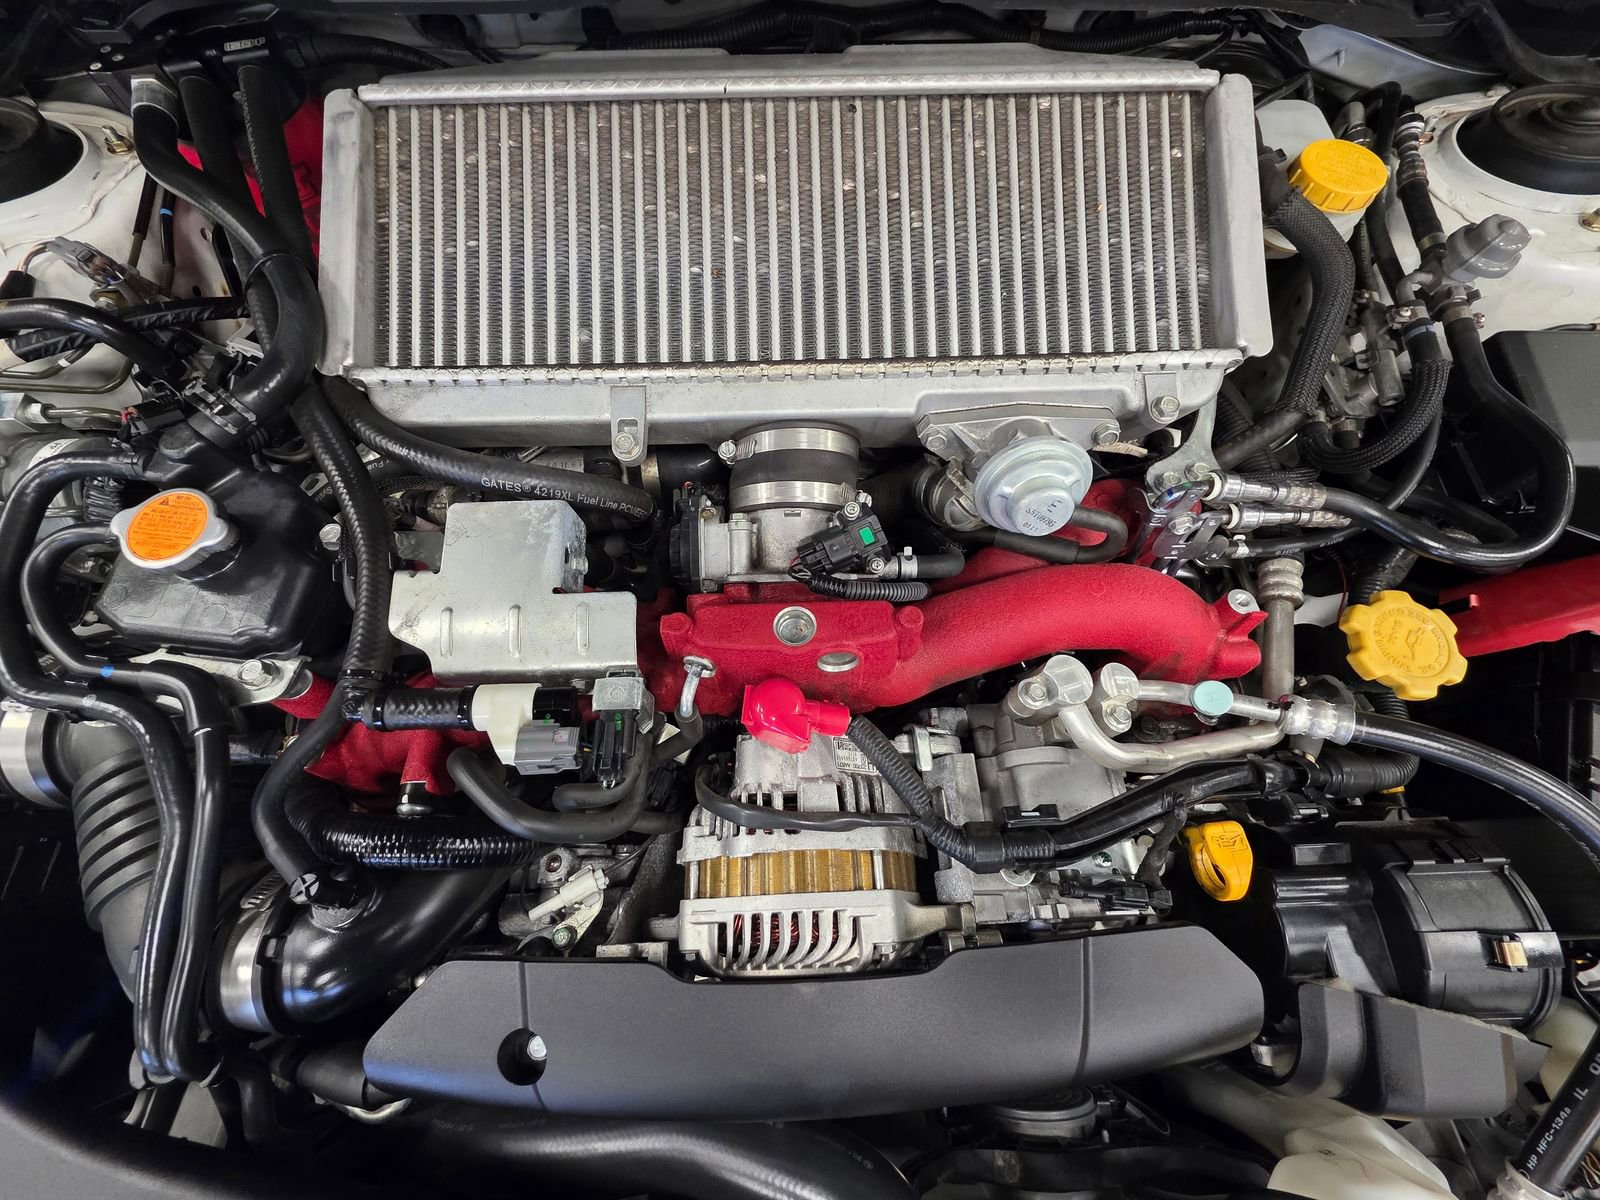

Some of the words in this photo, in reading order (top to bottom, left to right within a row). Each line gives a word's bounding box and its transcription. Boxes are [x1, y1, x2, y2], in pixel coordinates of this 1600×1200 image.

[534, 487, 574, 501] 4219XL
[577, 493, 598, 506] Fuel
[600, 499, 618, 510] Line
[1526, 1154, 1538, 1170] HP
[1536, 1106, 1572, 1154] HFC-134a
